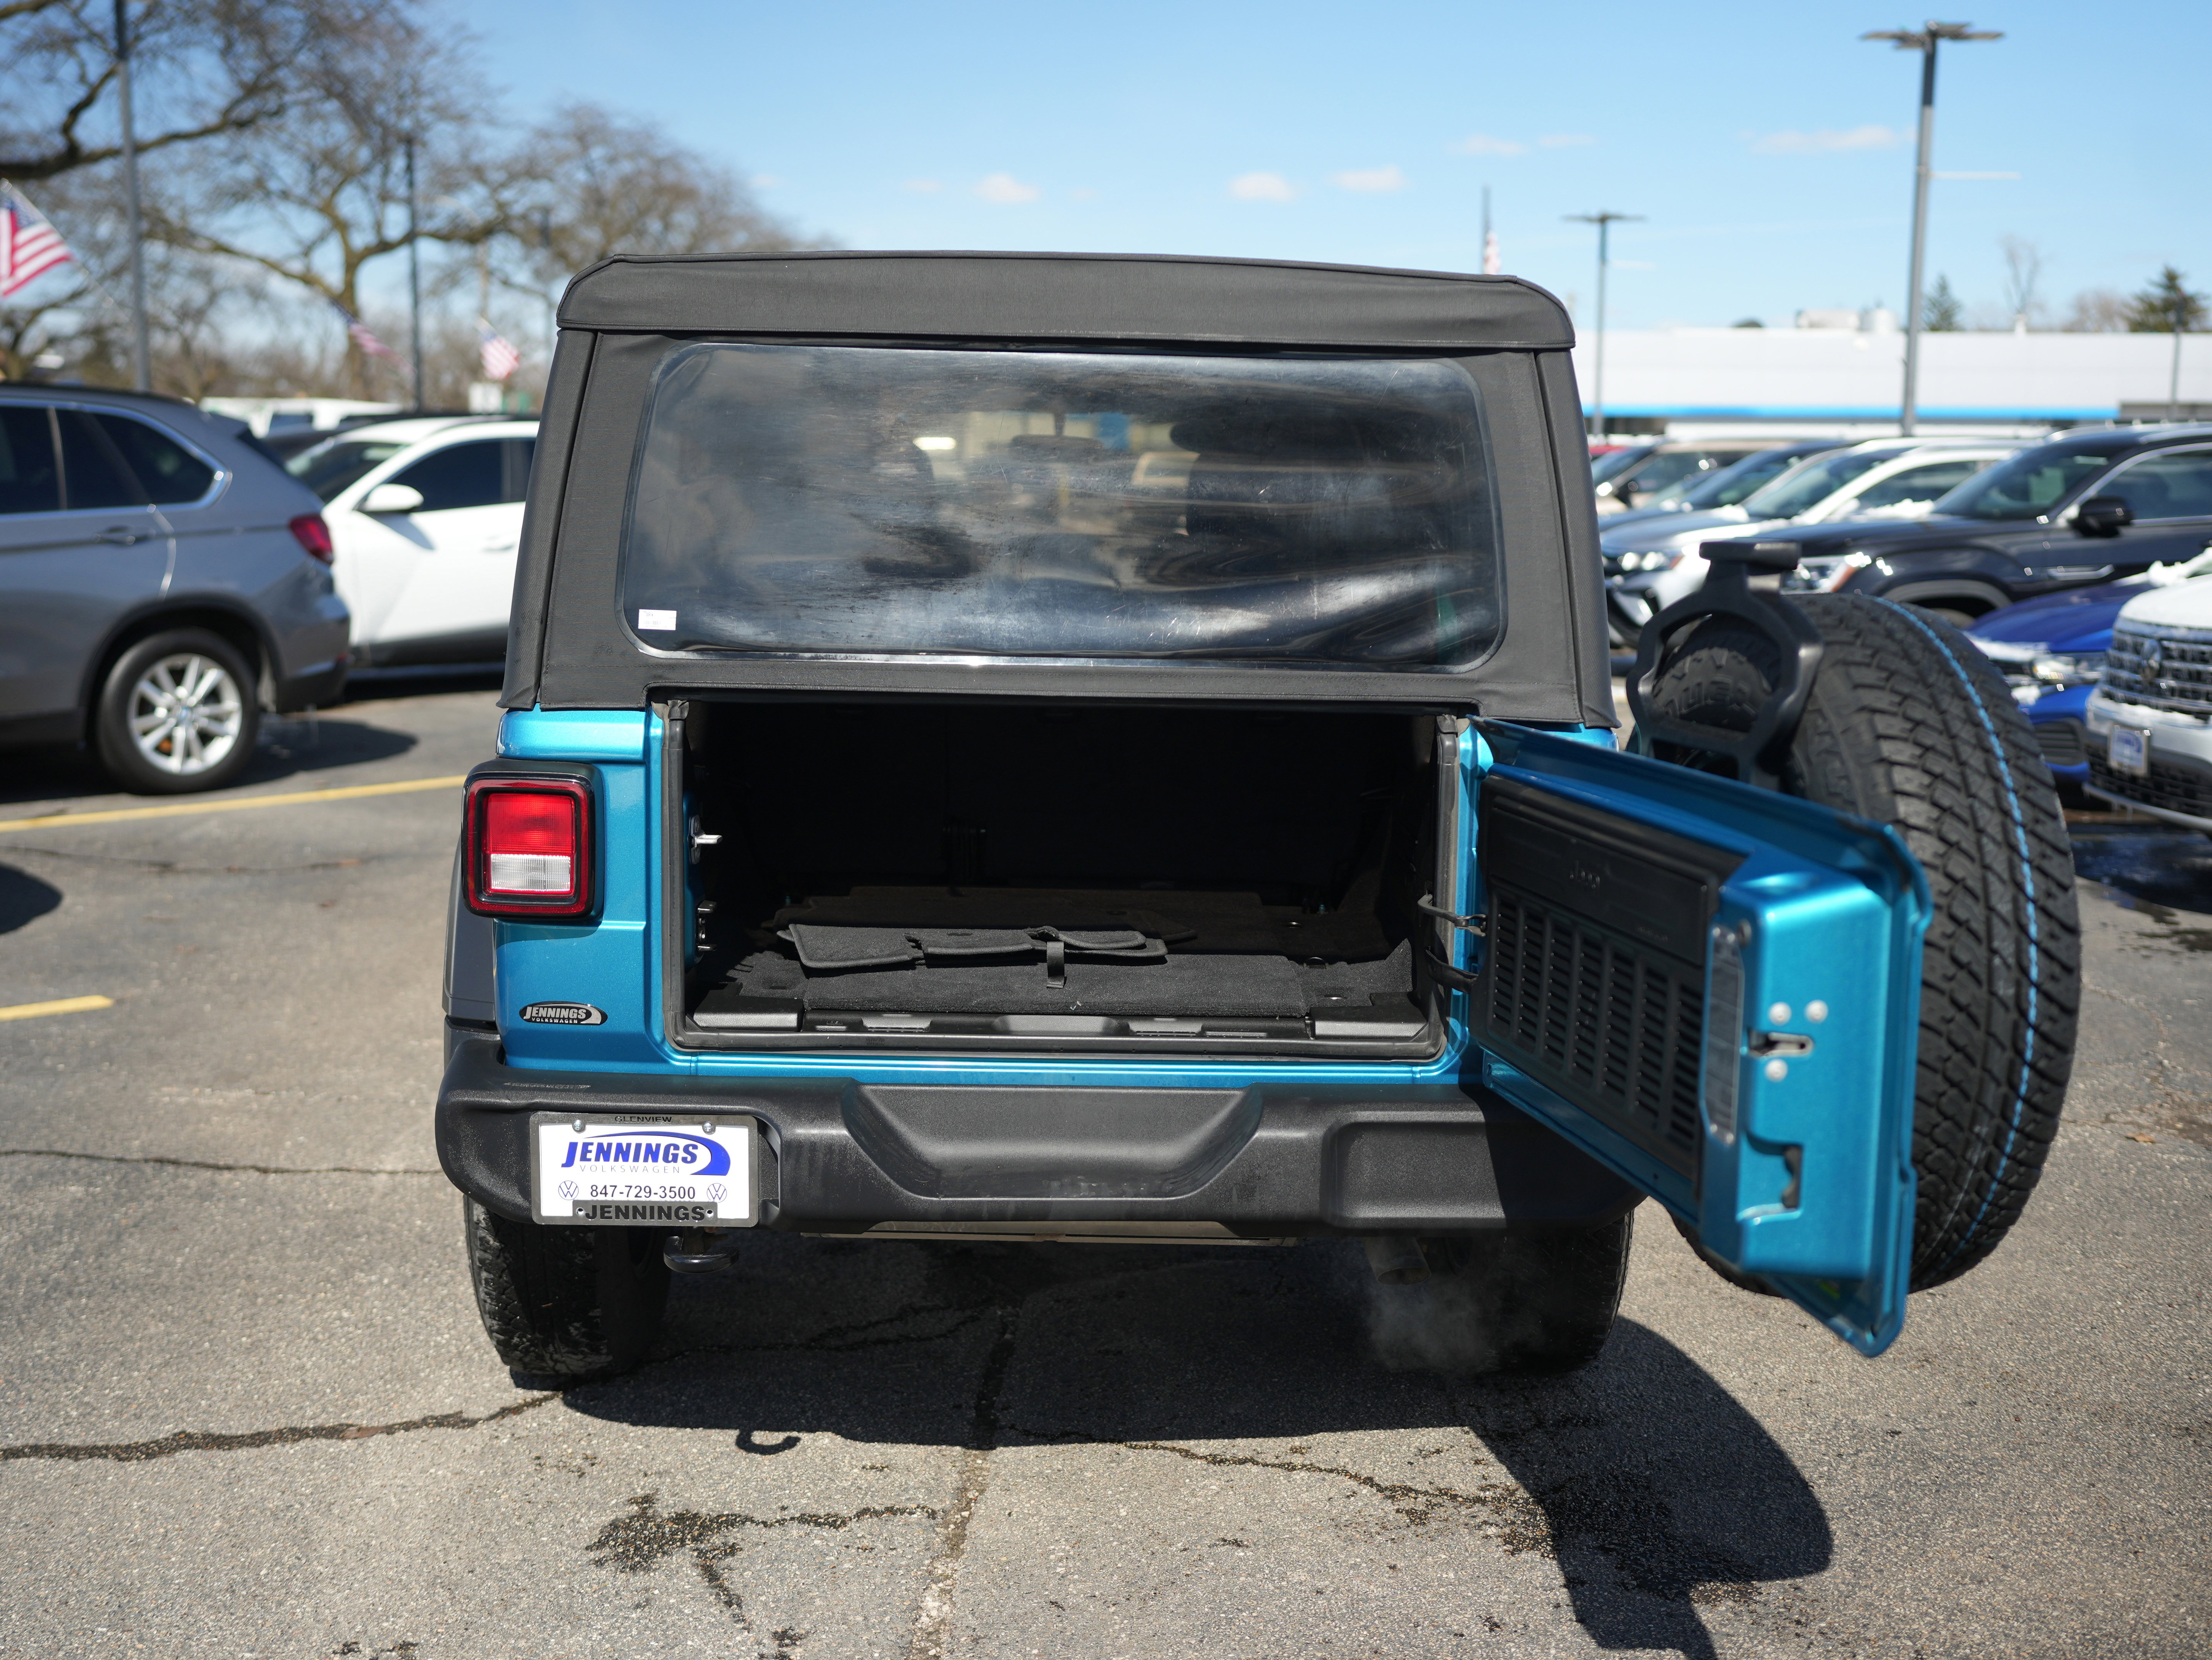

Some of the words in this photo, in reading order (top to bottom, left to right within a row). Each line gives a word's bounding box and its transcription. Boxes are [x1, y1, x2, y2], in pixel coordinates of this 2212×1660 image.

[523, 1006, 587, 1019] JENNINGS
[561, 1142, 698, 1167] JENNINGS
[580, 1164, 680, 1174] VOLKSWAGEN
[590, 1185, 696, 1199] 847-729-3500
[585, 1204, 705, 1222] JENNINGS
